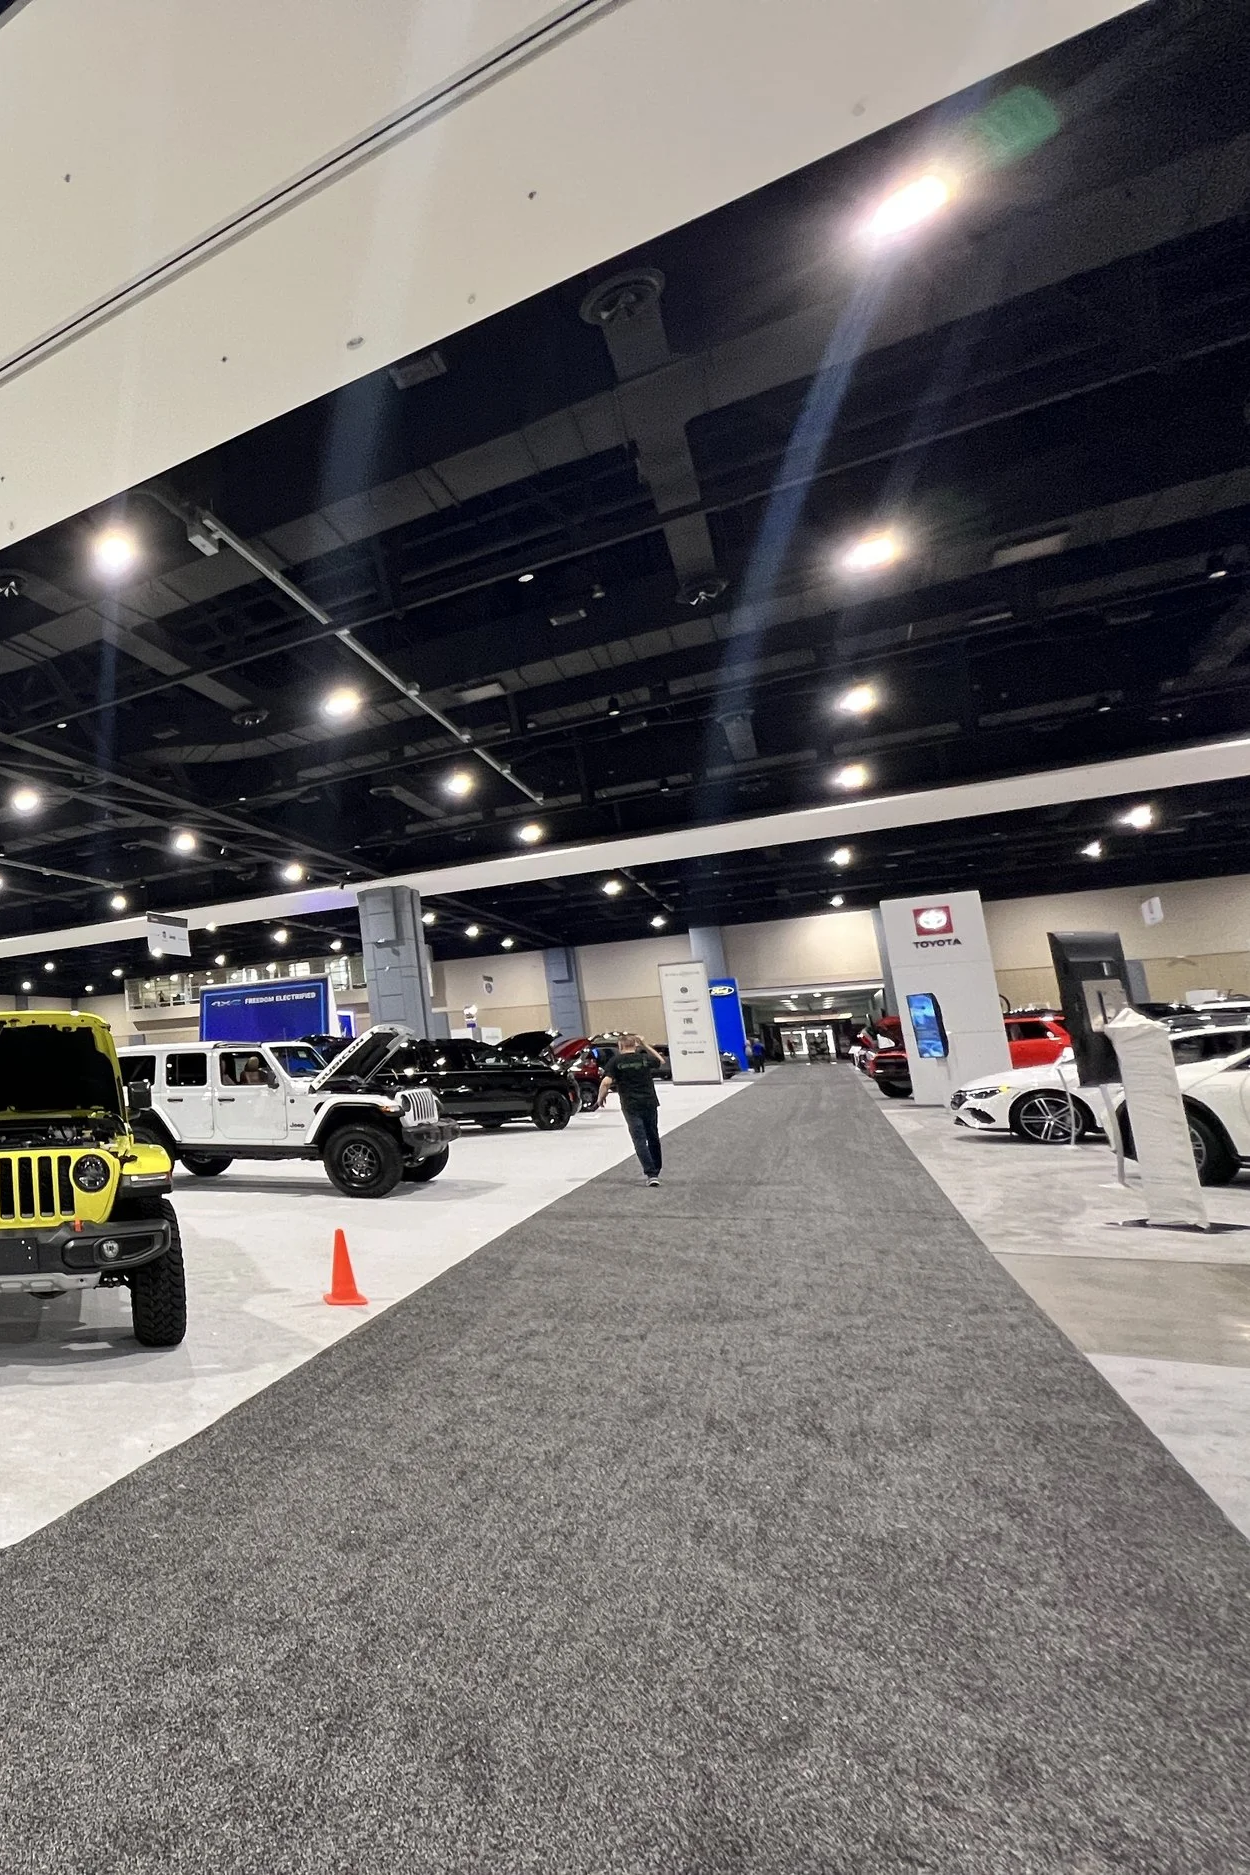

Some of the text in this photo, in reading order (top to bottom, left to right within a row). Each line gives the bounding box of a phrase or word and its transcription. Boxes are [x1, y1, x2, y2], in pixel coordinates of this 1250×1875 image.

[913, 938, 962, 949] TOYOTA
[245, 996, 274, 1004] FREEDOM
[275, 992, 316, 1001] ELECTRIFIED
[318, 1038, 364, 1085] RUBICON
